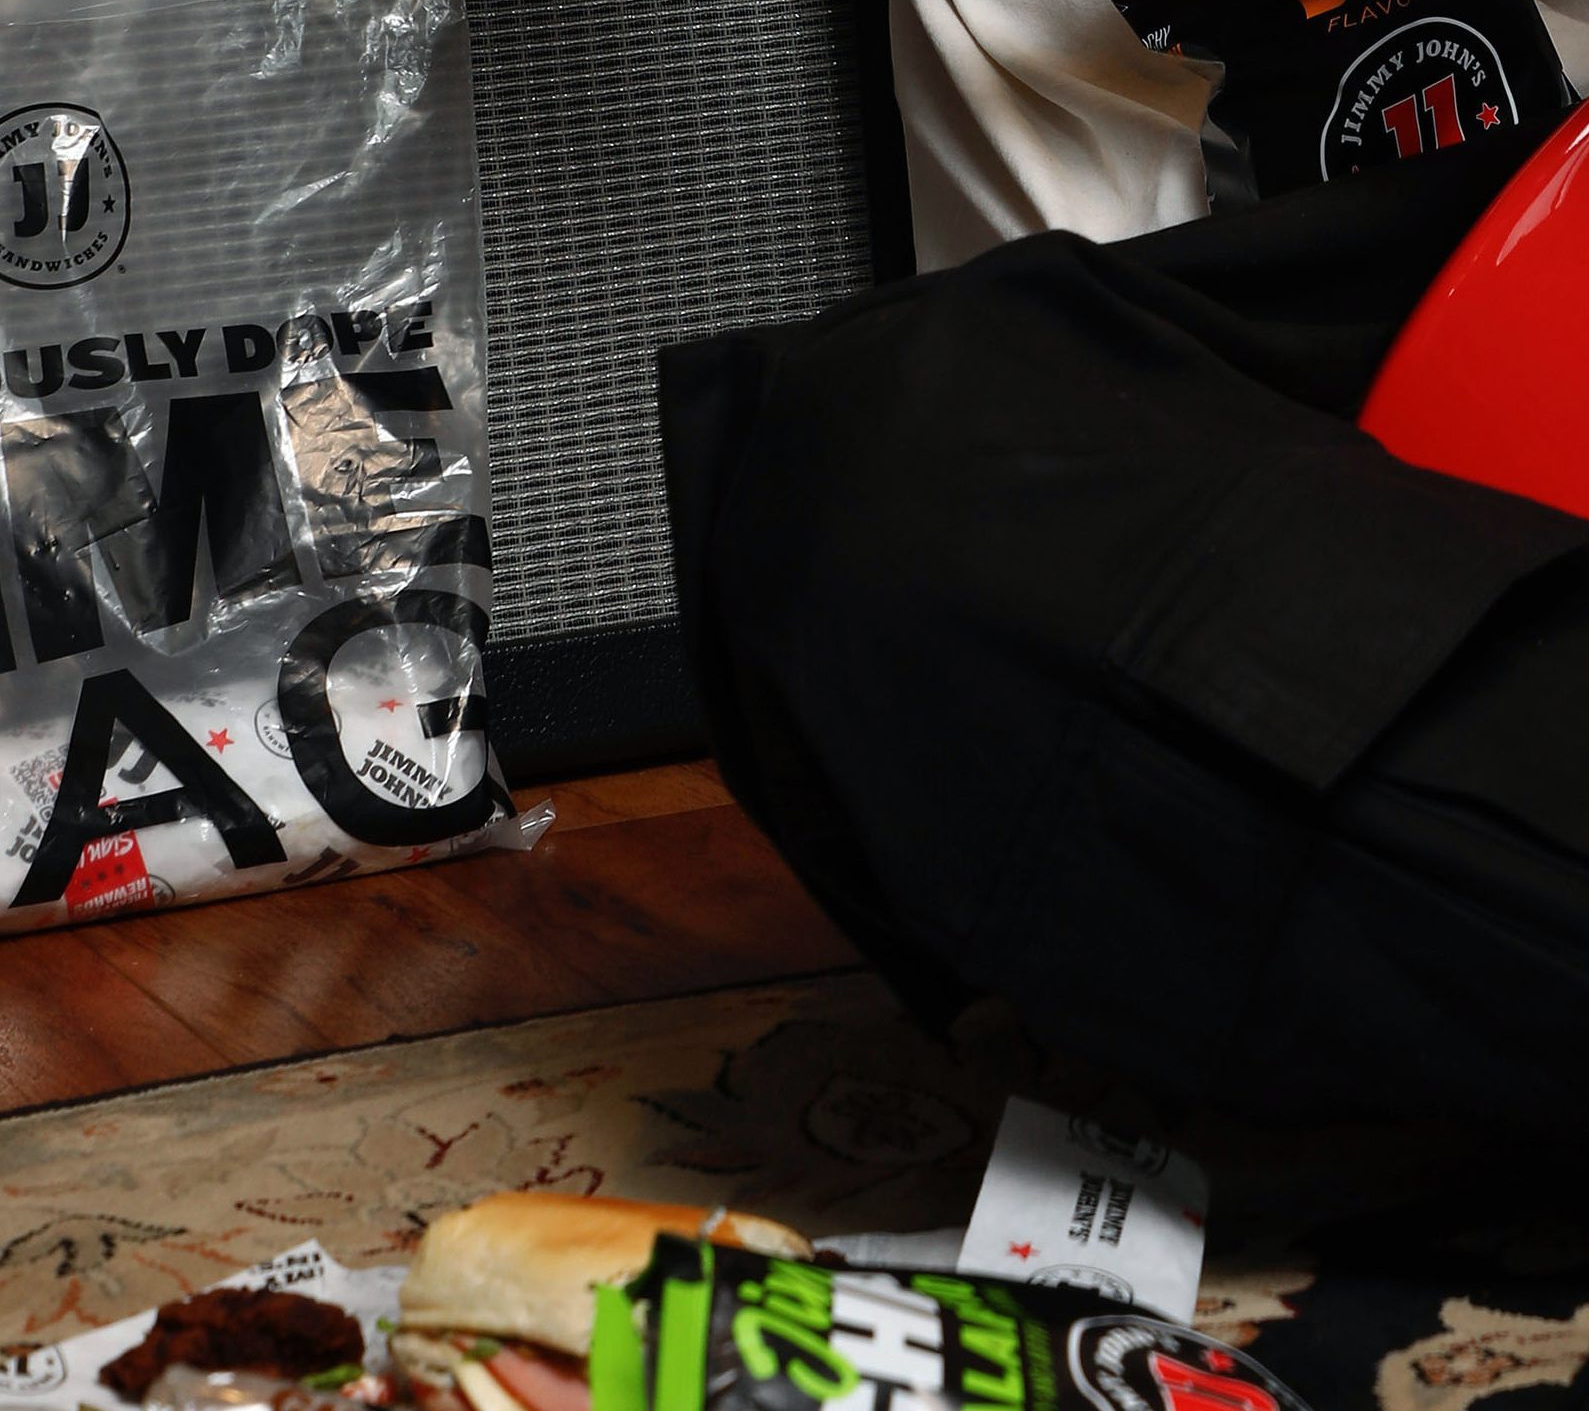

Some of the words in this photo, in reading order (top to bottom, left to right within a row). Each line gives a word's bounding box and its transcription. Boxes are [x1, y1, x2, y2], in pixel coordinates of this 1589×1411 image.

[1341, 50, 1405, 147] JIMMY
[1415, 39, 1488, 88] JOHN'S
[13, 157, 90, 238] JJ
[0, 231, 109, 273] ANDWICHES
[0, 327, 208, 399] USLY
[222, 301, 435, 374] DOPE
[0, 365, 493, 676] ME
[356, 758, 437, 810] JOHN'
[367, 738, 455, 801] JIMMY
